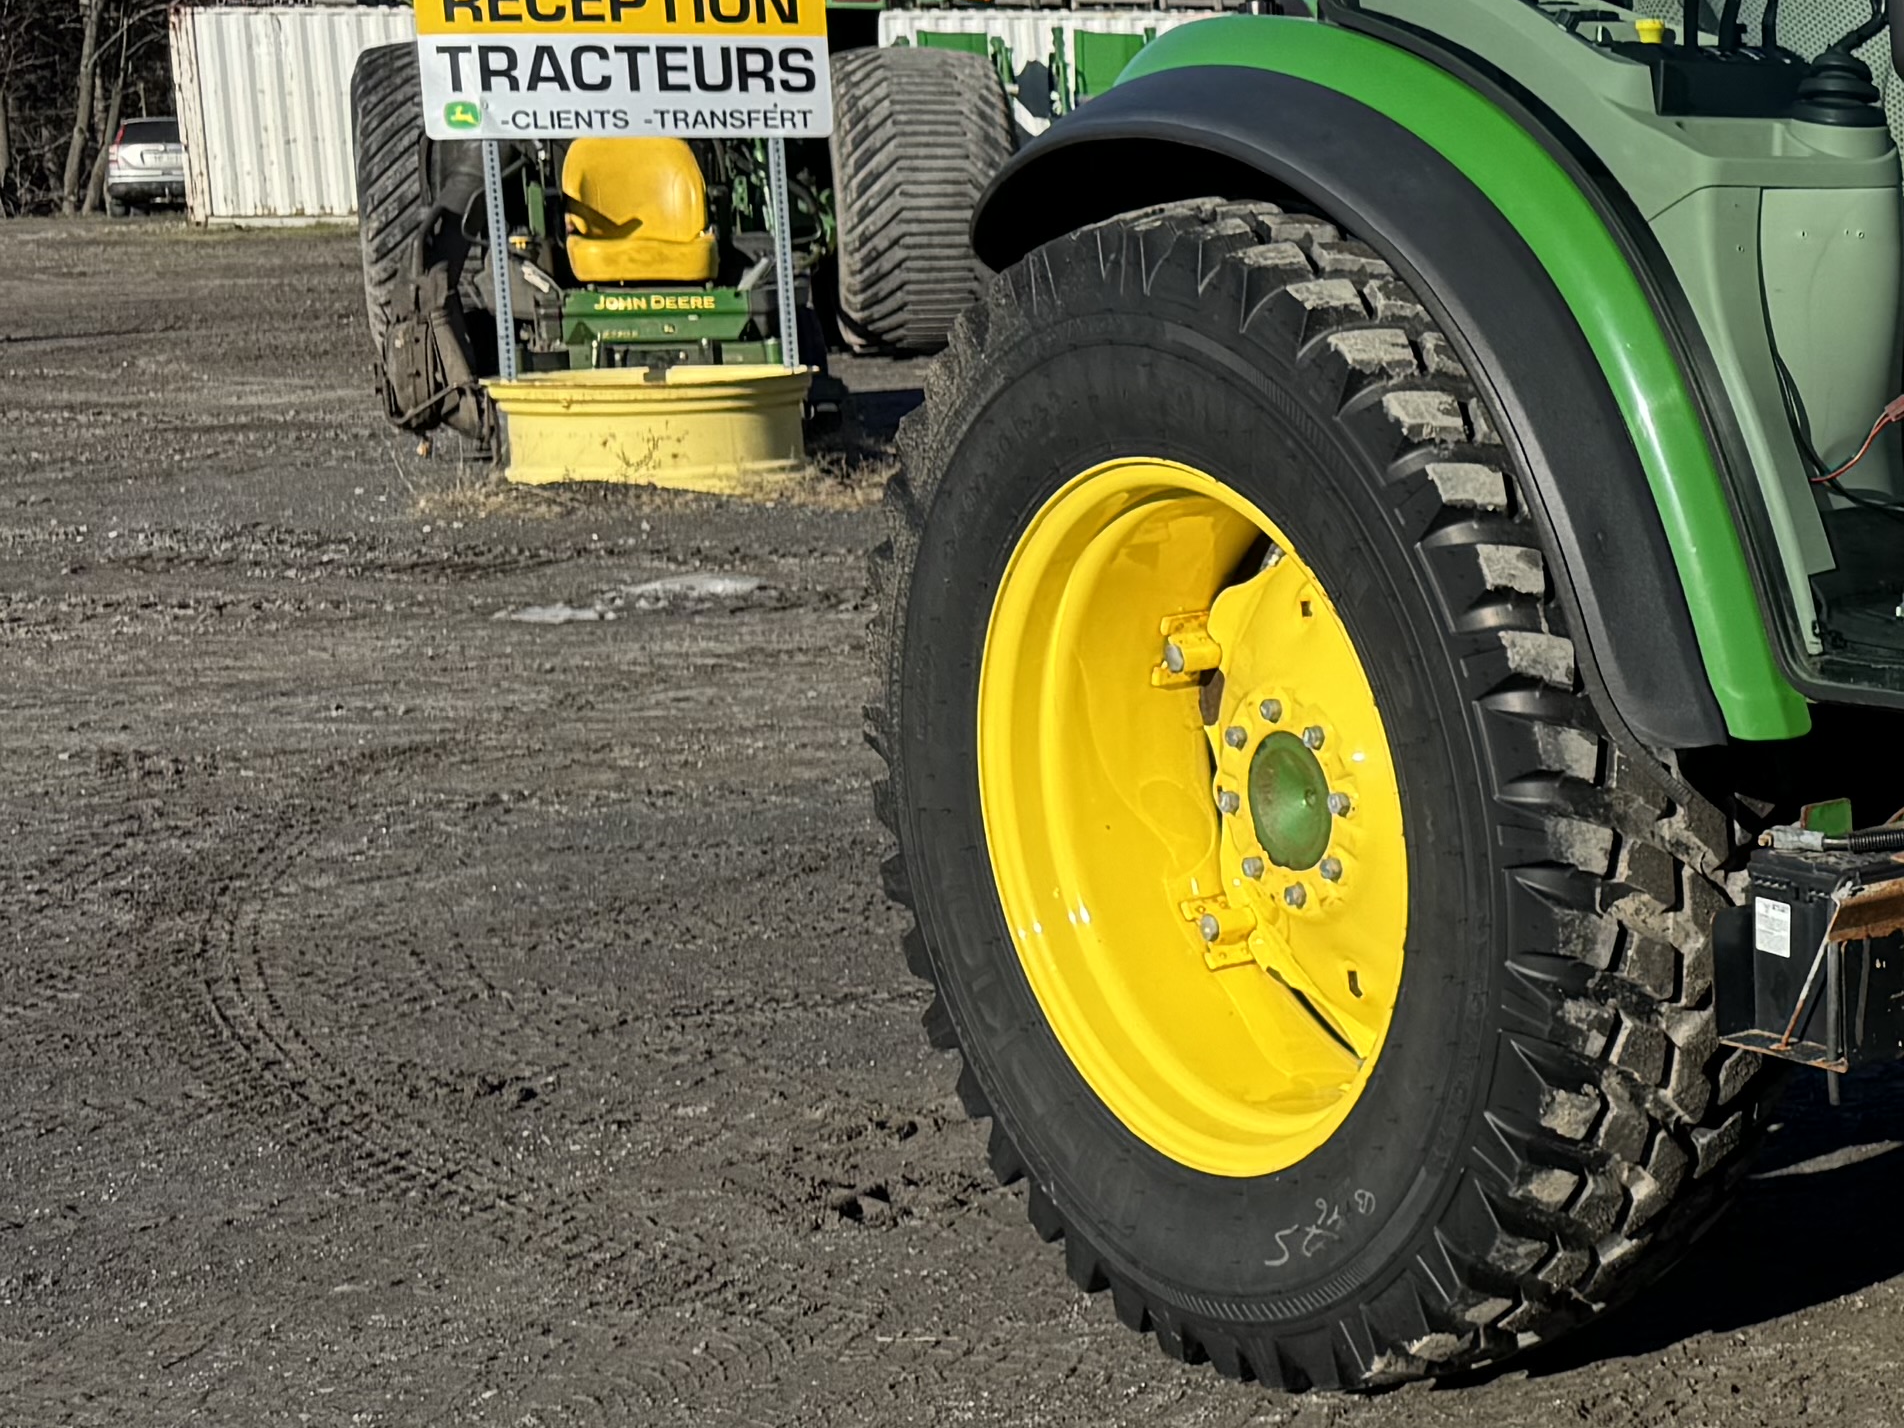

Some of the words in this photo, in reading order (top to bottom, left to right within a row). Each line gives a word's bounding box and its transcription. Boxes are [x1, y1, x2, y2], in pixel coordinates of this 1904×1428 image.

[436, 45, 816, 94] TRACTEURS
[594, 294, 648, 311] JOHN
[650, 294, 716, 310] DEERE
